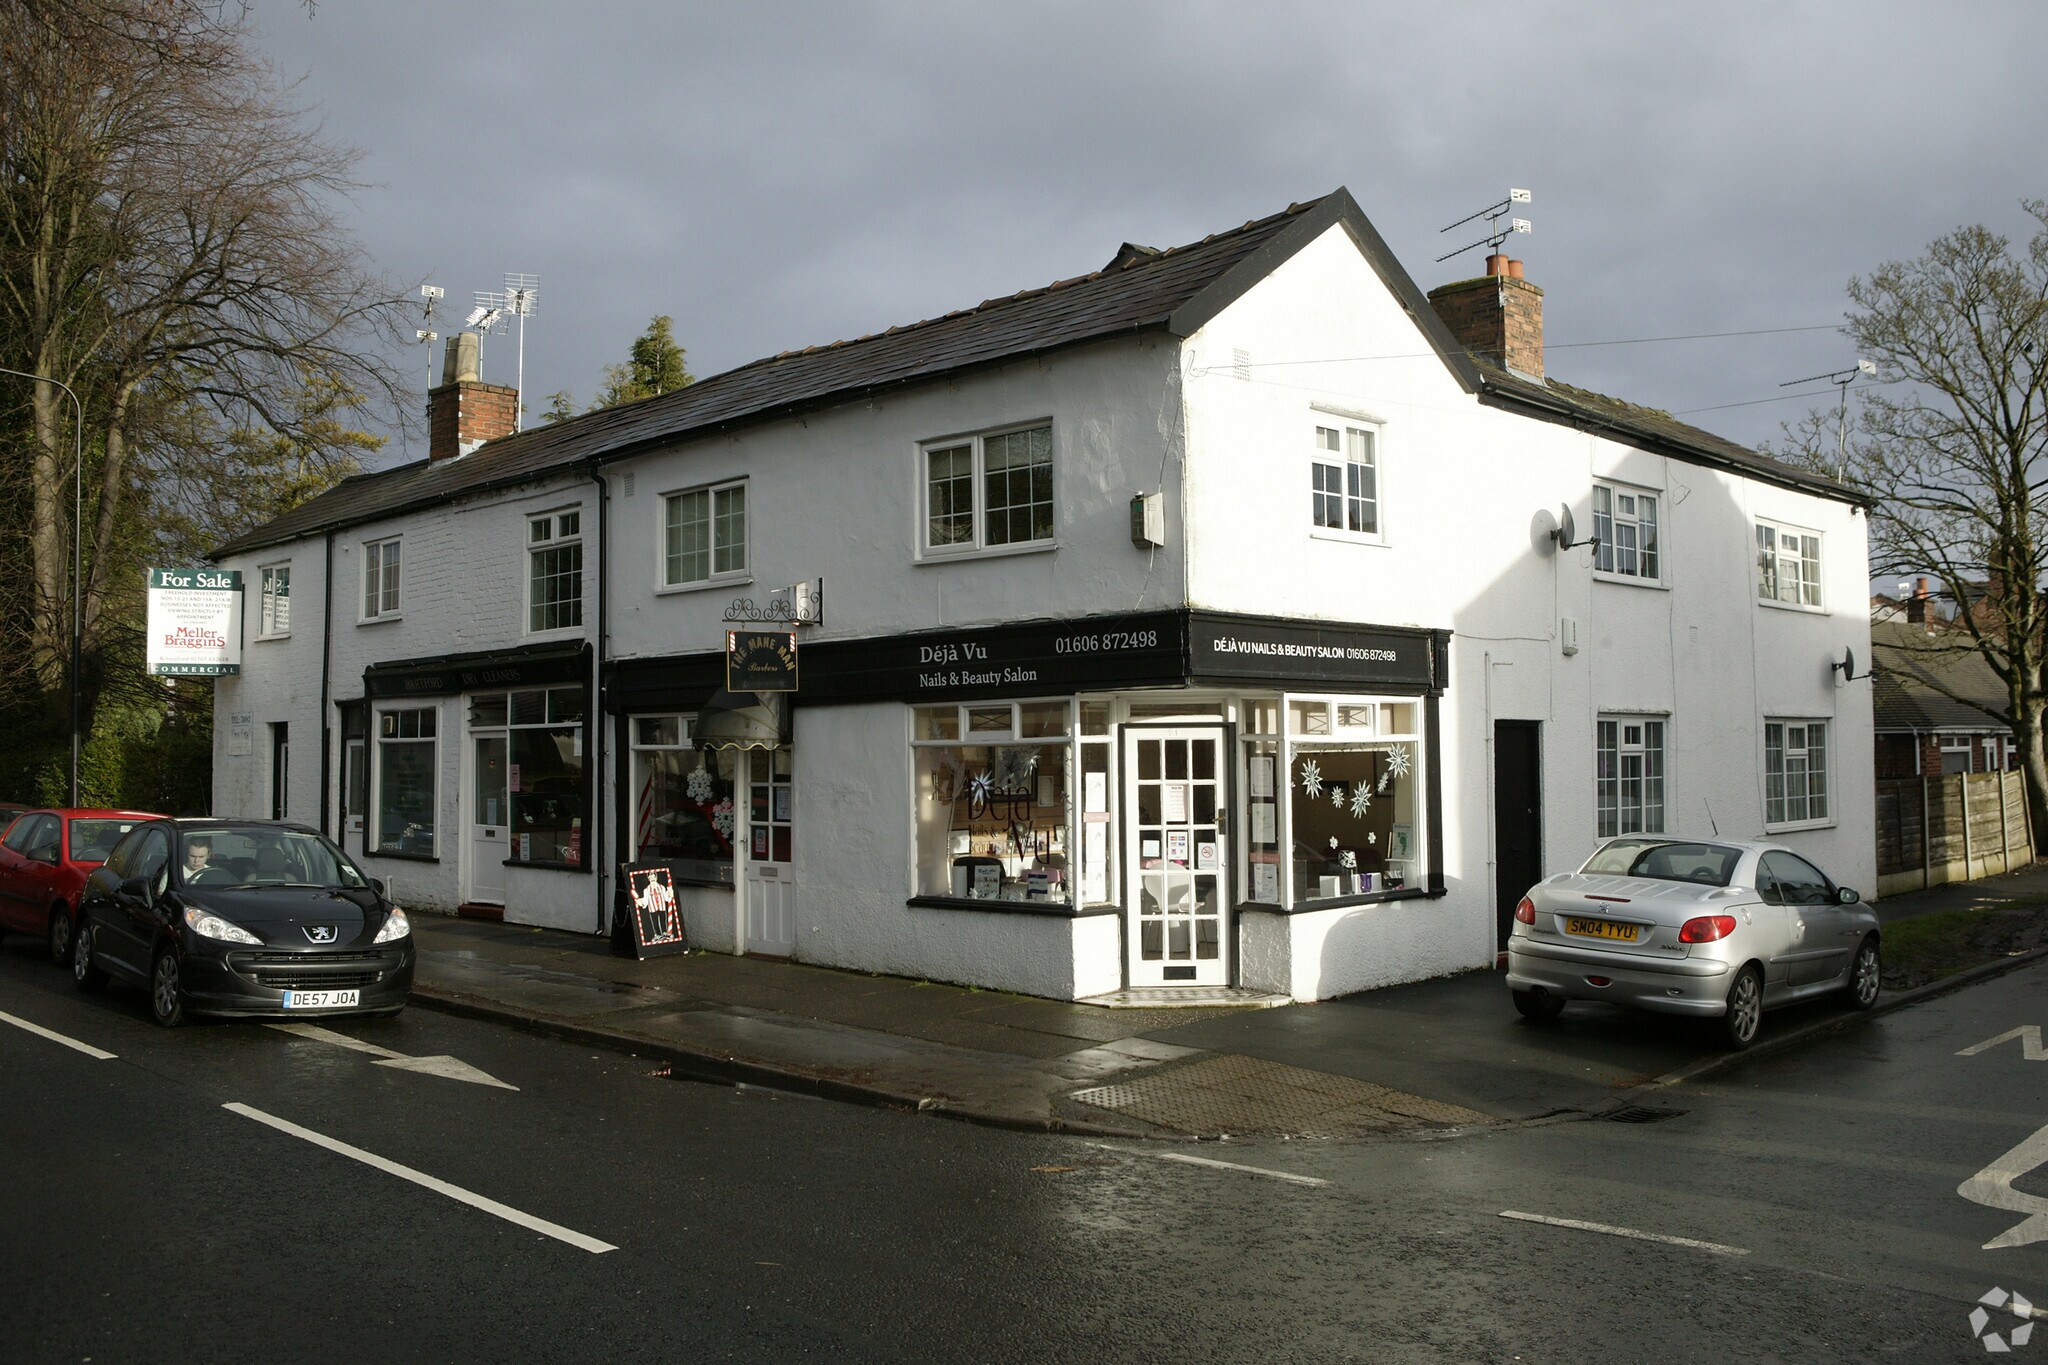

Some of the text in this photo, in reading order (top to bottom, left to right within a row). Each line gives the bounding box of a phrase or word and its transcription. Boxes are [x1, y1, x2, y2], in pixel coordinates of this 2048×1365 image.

[160, 572, 232, 588] For Sale
[175, 626, 218, 639] Meller
[962, 642, 988, 660] Vu
[1055, 630, 1158, 654] 01606 872498
[730, 636, 796, 671] THE MANE MAN
[1237, 641, 1251, 653] VU
[1251, 642, 1277, 655] NAILS
[1277, 644, 1285, 656] &
[1285, 644, 1318, 657] BEAUTY
[1317, 646, 1345, 659] SALON
[1346, 647, 1370, 660] 01606
[1369, 649, 1396, 662] 872498
[152, 665, 236, 674] COMMERCIAL
[748, 662, 779, 672] Barbers
[403, 676, 443, 691] HARTFORD
[481, 668, 522, 683] CLEANERS
[919, 666, 1038, 688] Nails & Beauty Salon
[1011, 820, 1050, 864] Vu
[1571, 920, 1603, 935] SM04
[1607, 923, 1633, 938] TYU
[292, 991, 357, 1006] DE57 JOA
